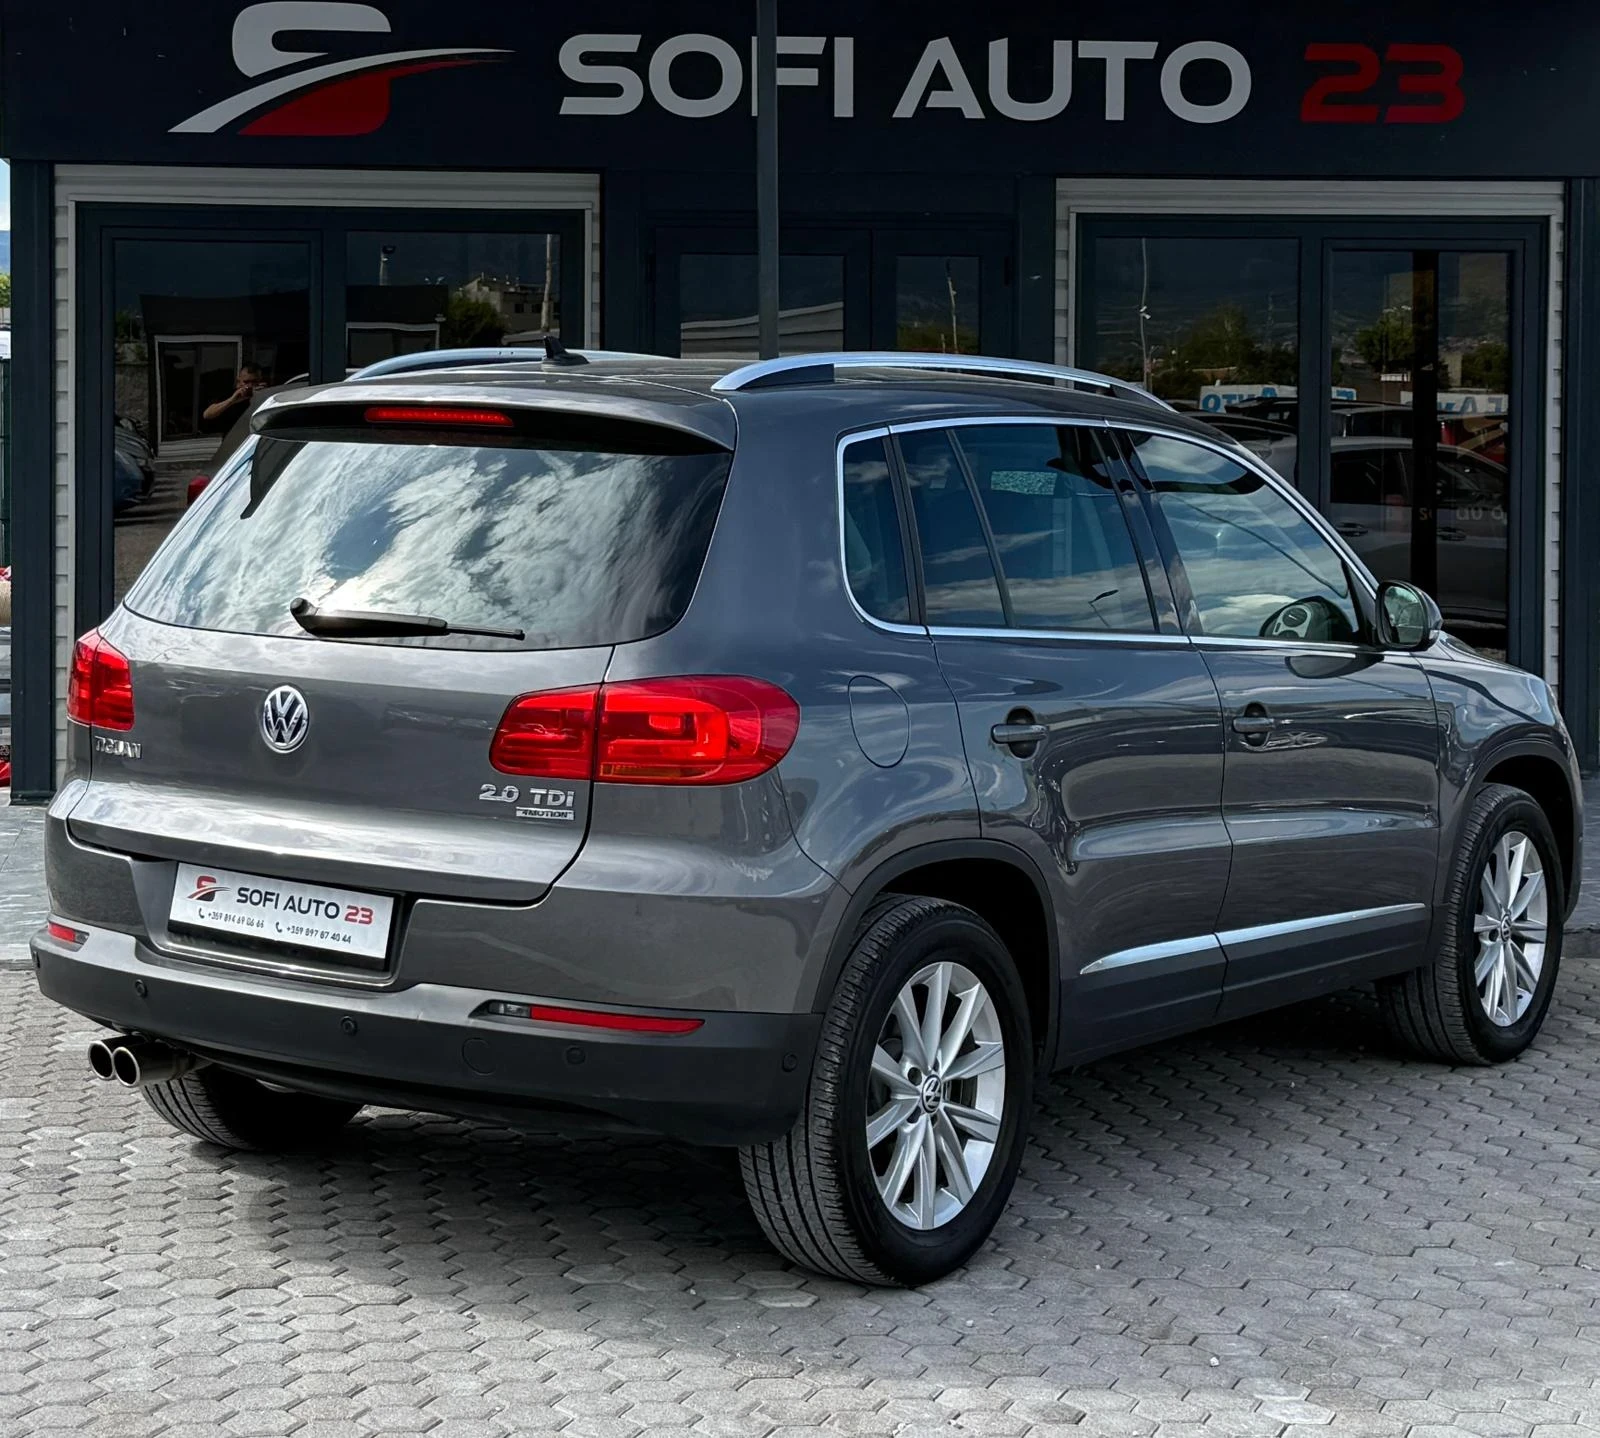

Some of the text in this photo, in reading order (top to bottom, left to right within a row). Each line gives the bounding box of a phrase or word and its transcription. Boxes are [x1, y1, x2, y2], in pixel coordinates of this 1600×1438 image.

[558, 33, 1466, 124] SOFI AUTO 23
[521, 809, 568, 818] 4MOTION
[236, 887, 373, 925] SOFI AUTO 23
[208, 911, 223, 922] +359
[286, 925, 352, 944] +359 897 87 40 44
